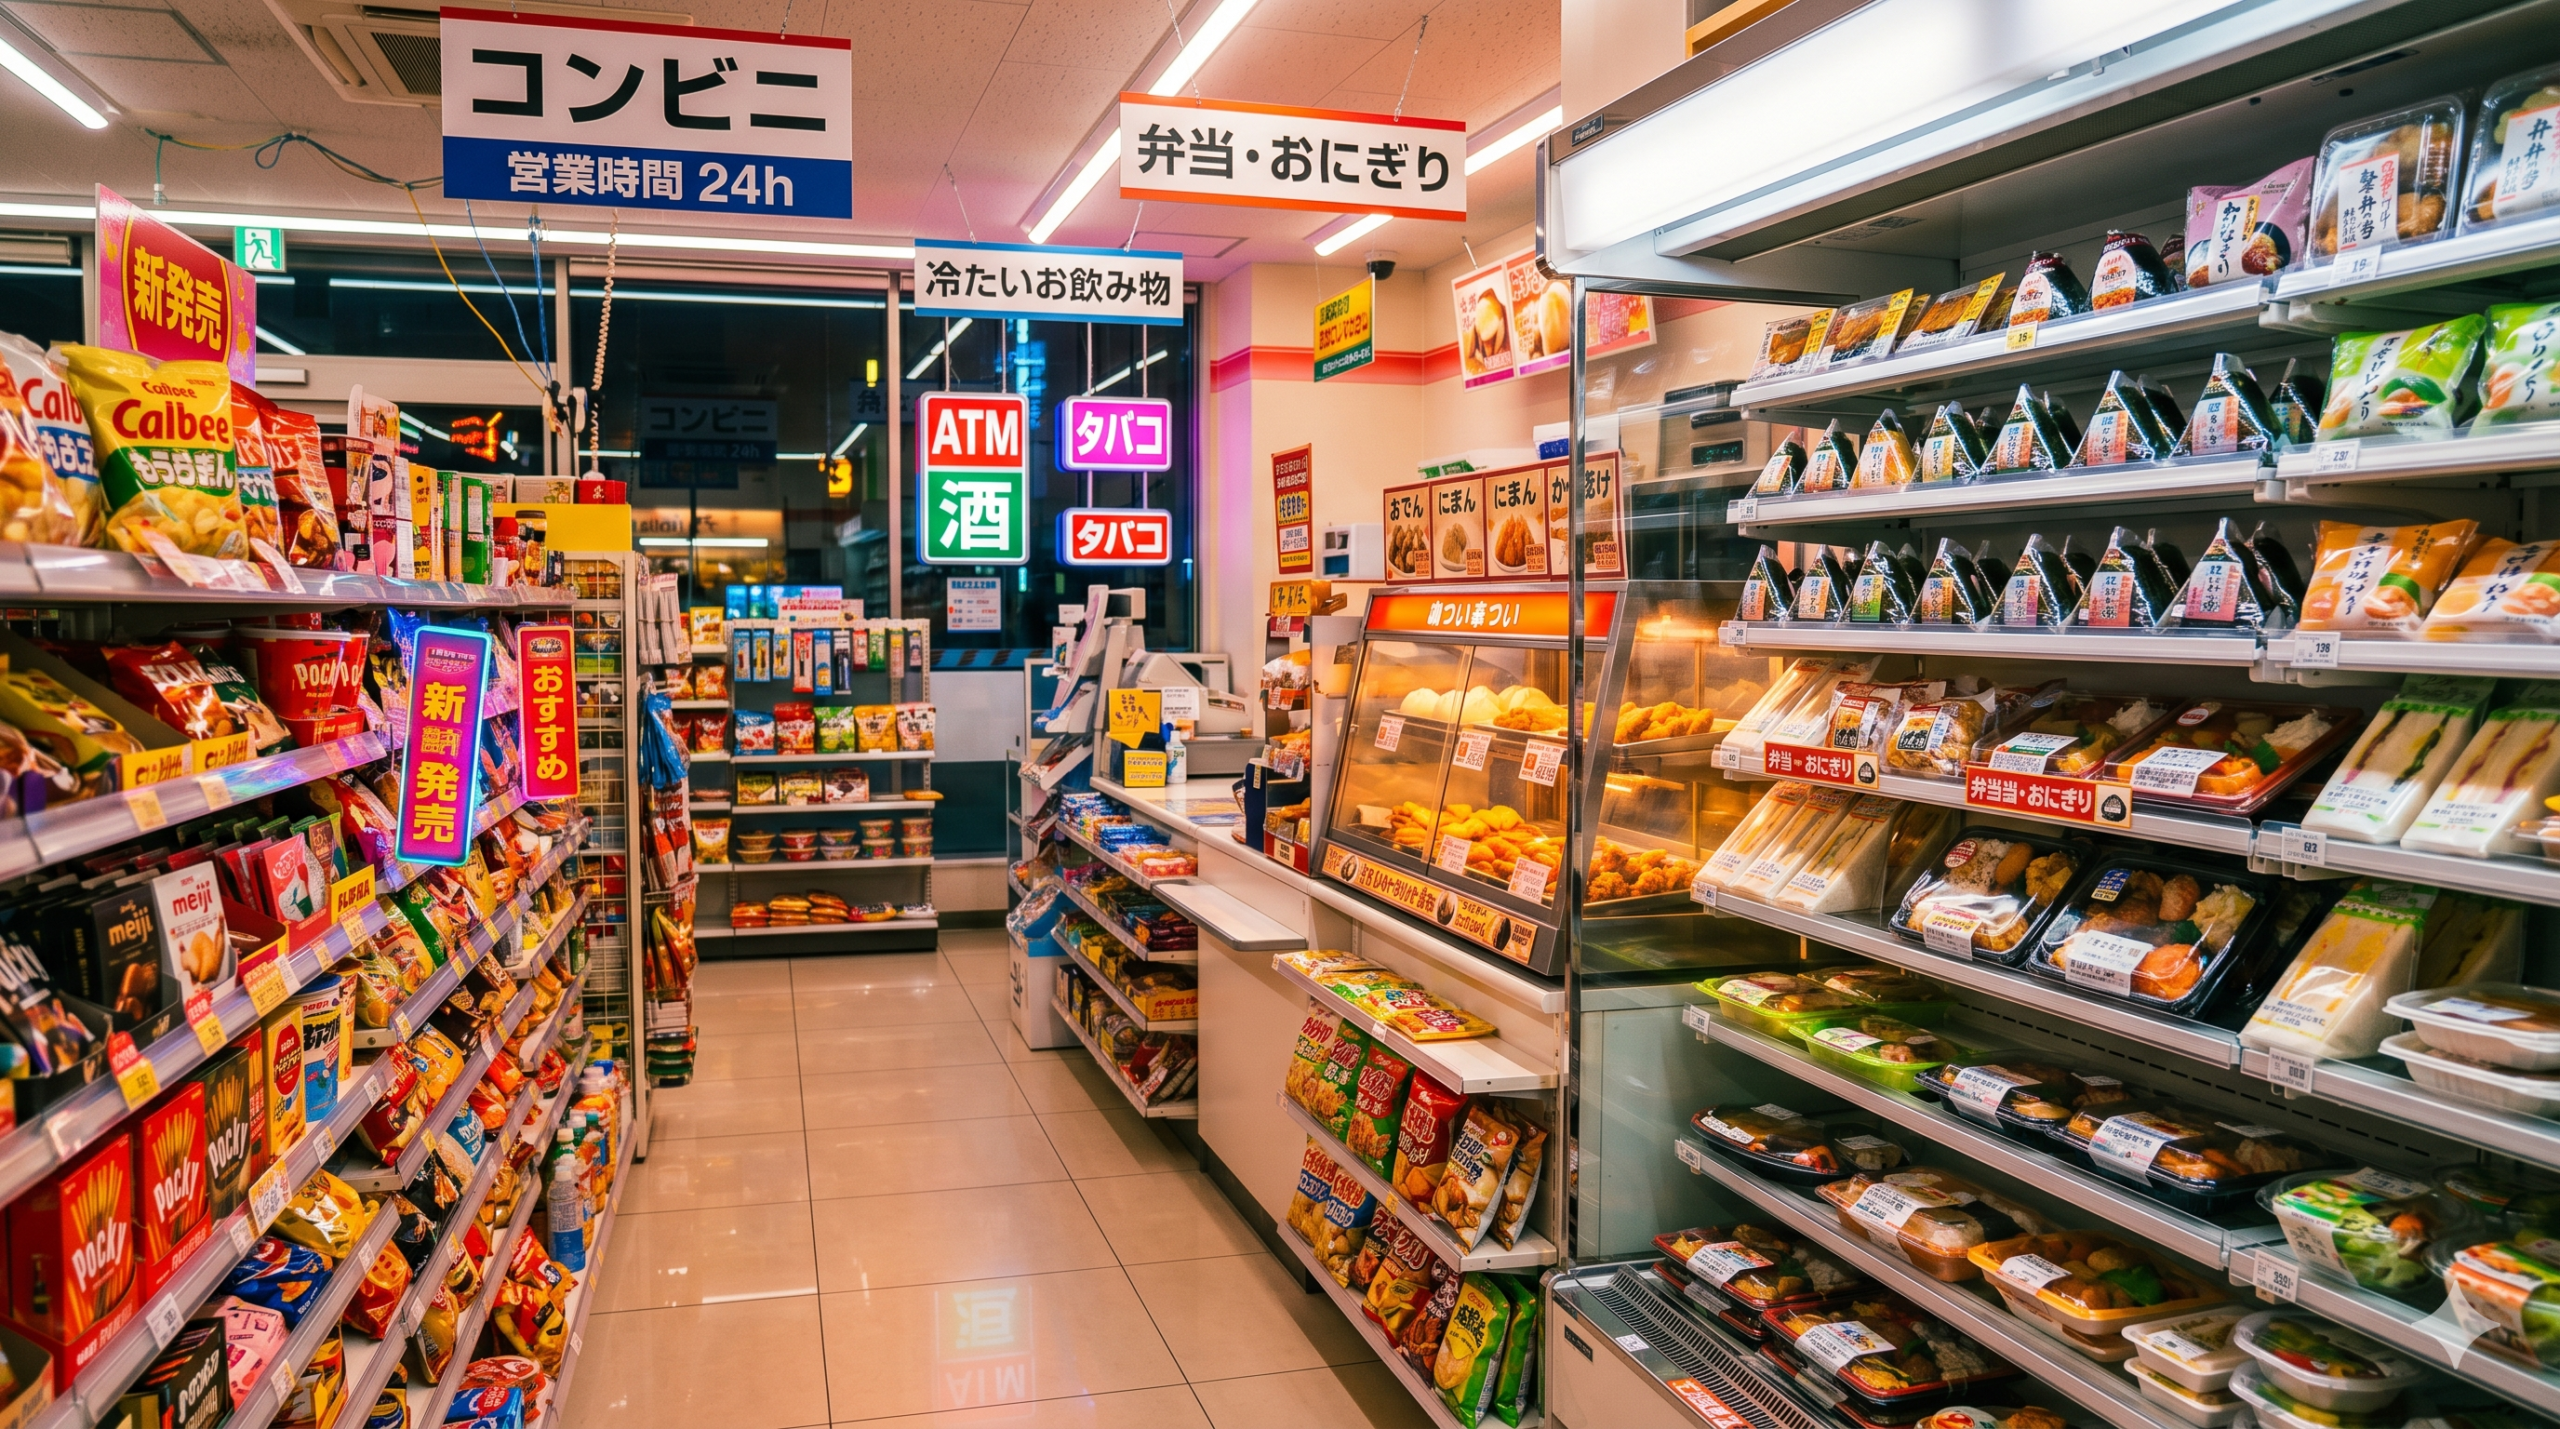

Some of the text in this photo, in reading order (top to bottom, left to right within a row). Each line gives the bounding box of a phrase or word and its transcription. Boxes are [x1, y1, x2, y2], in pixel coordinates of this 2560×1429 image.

[472, 48, 826, 132] コンビニ
[507, 150, 794, 207] 営業時間 24h
[1137, 123, 1450, 192] 弁当・おにぎり
[133, 245, 222, 351] 新発売
[925, 260, 1171, 306] 冷たいお飲み物
[112, 398, 230, 444] Calbee
[931, 408, 1018, 456] ATM
[1076, 410, 1163, 456] タバコ
[939, 479, 1012, 551] 酒
[1389, 494, 1424, 521] おでん
[1438, 487, 1476, 515] にまん
[1494, 478, 1537, 510] にまん
[1076, 519, 1163, 555] タバコ
[532, 665, 569, 781] おすすめ
[172, 880, 213, 917] meiji
[108, 906, 153, 946] meiji
